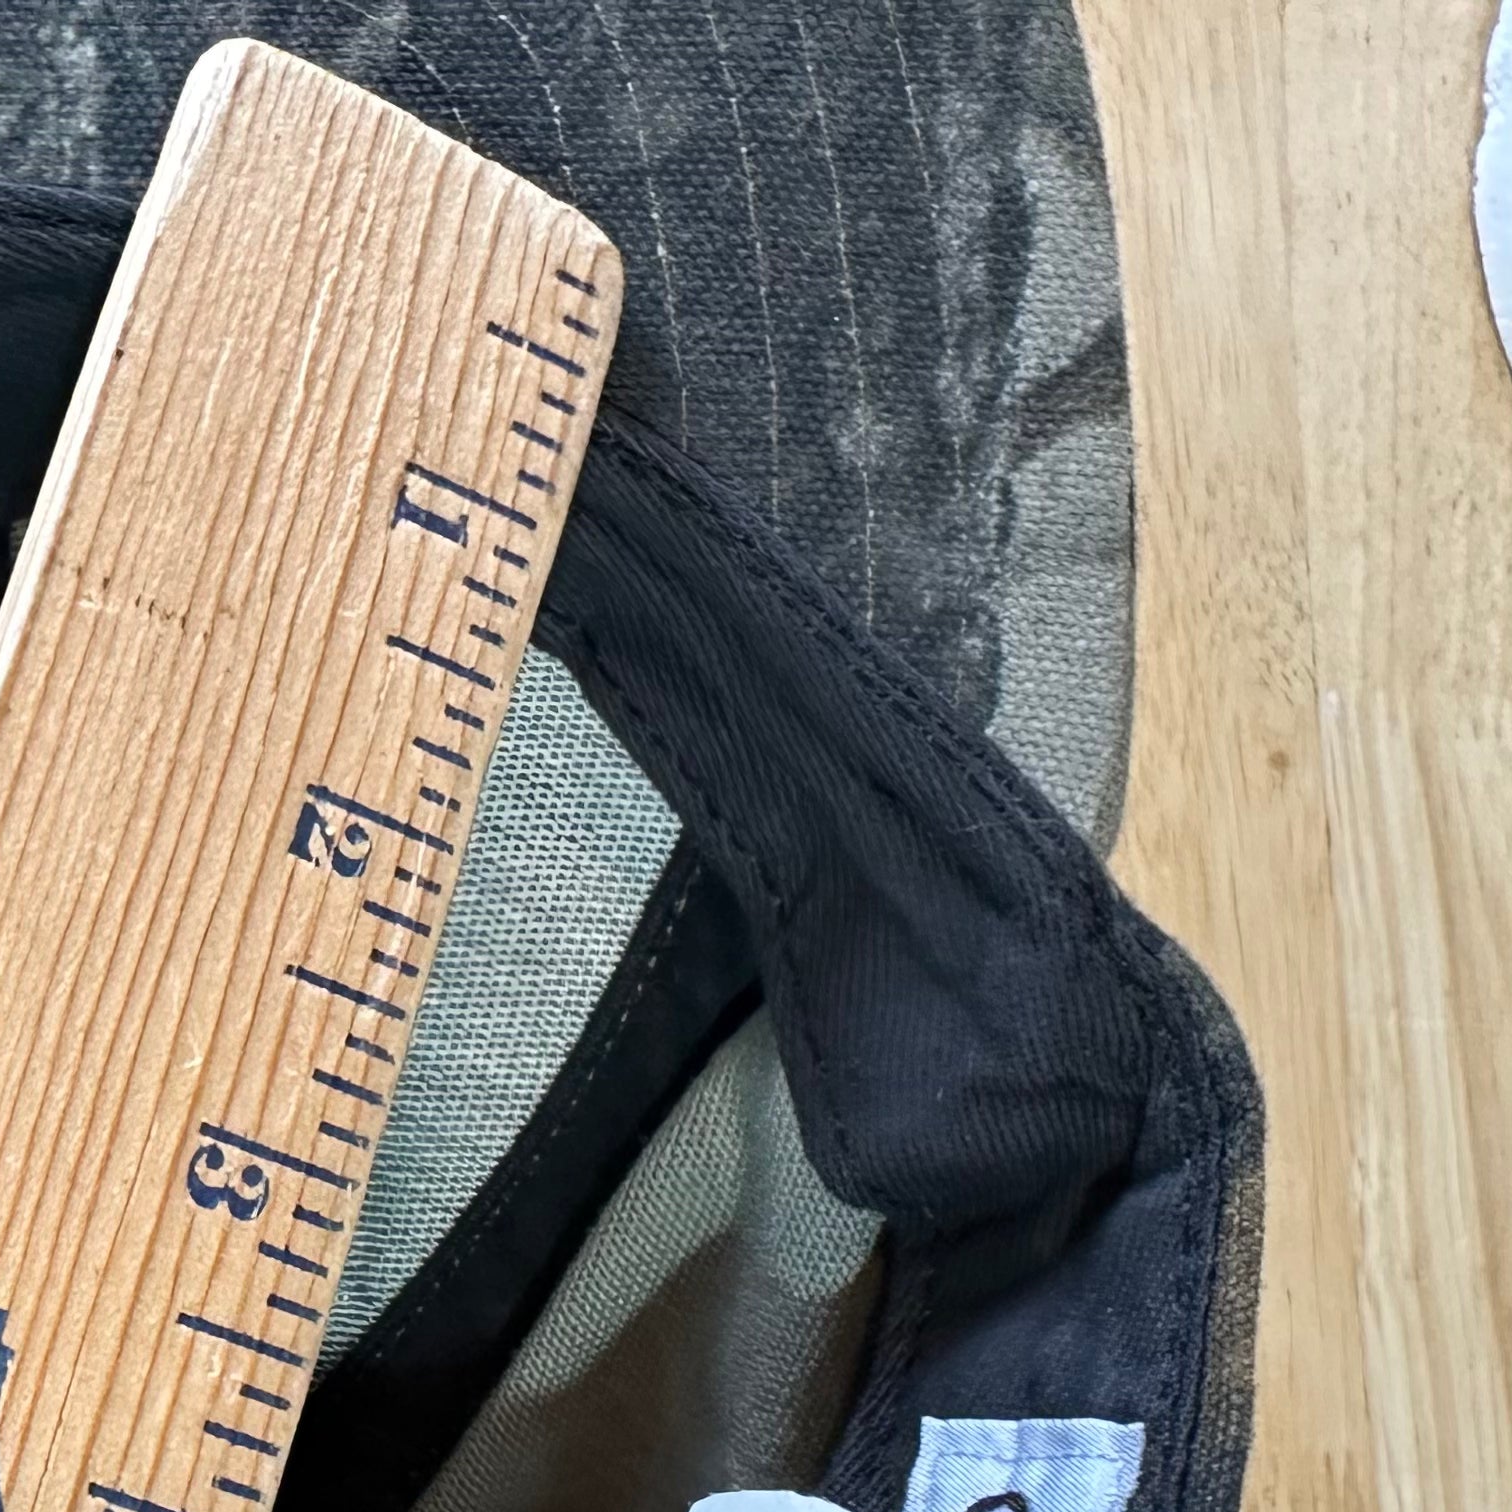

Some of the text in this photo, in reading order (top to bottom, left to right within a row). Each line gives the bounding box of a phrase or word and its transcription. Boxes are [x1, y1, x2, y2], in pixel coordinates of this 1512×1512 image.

[391, 486, 469, 548] 1
[288, 802, 372, 878] 2
[187, 1144, 271, 1222] 3
